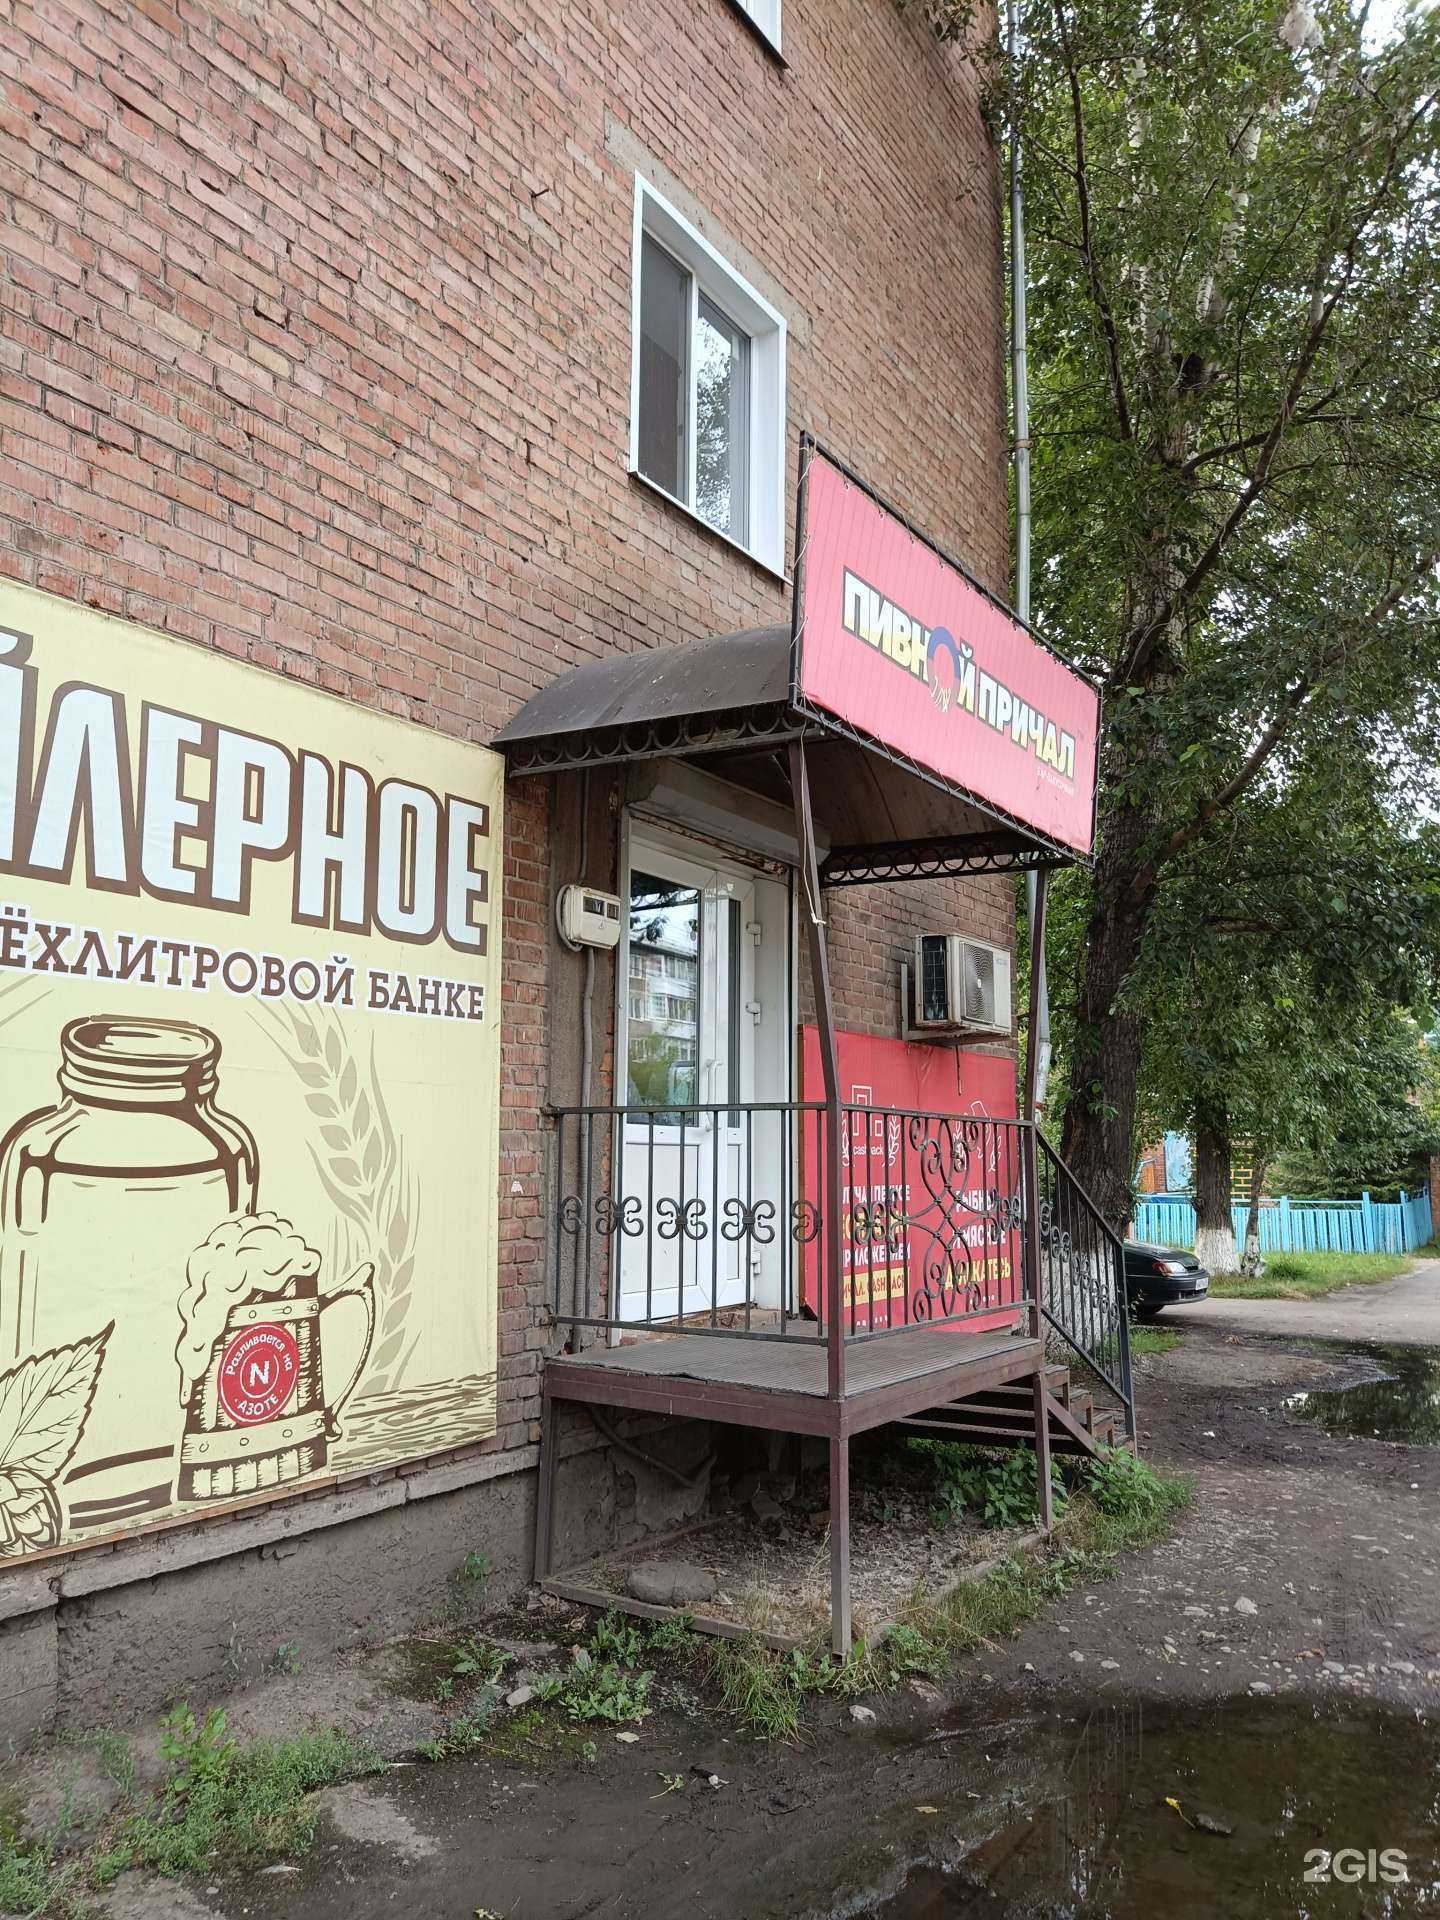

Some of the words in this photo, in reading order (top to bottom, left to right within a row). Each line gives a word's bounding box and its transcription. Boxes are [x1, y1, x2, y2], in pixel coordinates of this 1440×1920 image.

[843, 565, 977, 712] ПИВНОЙ
[977, 668, 1076, 780] ПРИЧАЛ
[368, 971, 484, 1021] БАНКЕ
[225, 1333, 285, 1376] Разливается
[282, 1354, 293, 1371] на
[249, 1360, 270, 1387] N
[236, 1393, 279, 1415] АЗОТЕ
